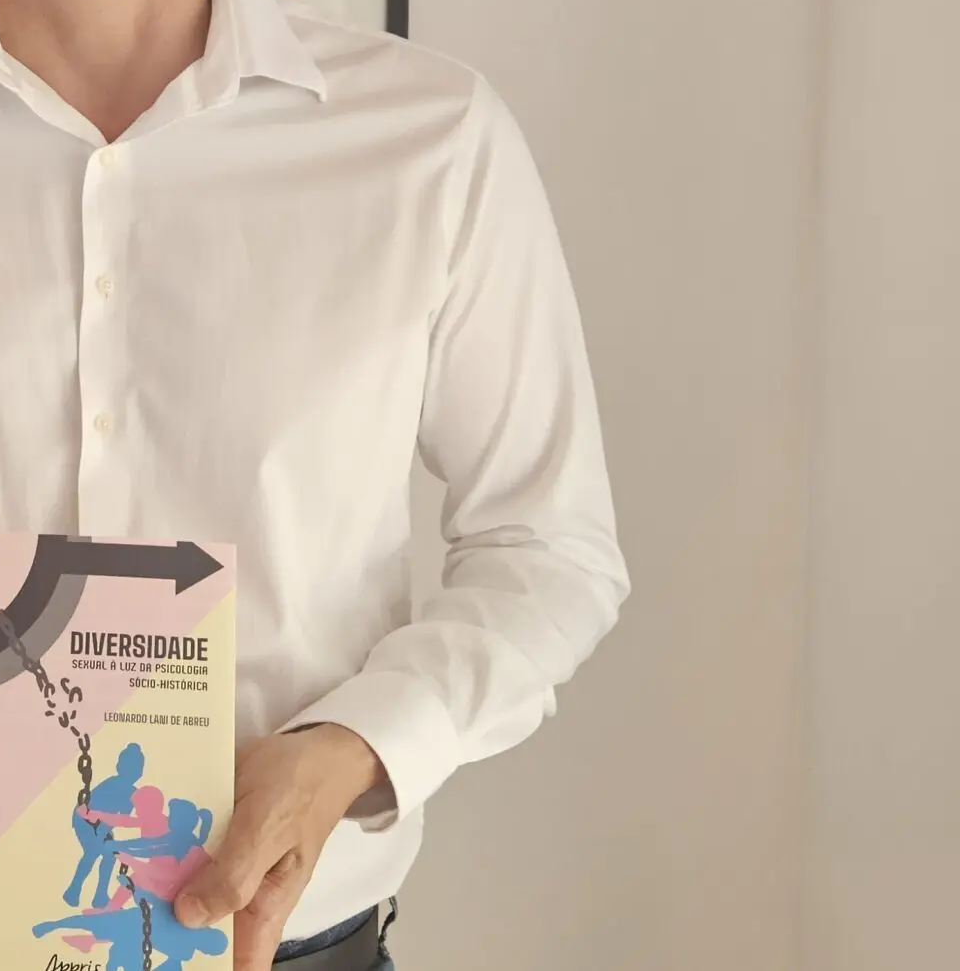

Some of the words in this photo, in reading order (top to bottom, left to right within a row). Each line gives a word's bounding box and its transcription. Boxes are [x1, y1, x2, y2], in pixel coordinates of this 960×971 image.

[70, 631, 208, 661] DIVERSIDADE
[72, 659, 107, 671] SEXUAL
[110, 660, 117, 671] À
[120, 662, 136, 672] LUZ
[140, 663, 152, 673] DA
[155, 663, 208, 675] PSICOLOGIA
[129, 677, 208, 691] SÓCIO-HISTÓRICA
[104, 712, 147, 725] LEONARDO
[149, 713, 168, 725] LANI
[170, 714, 181, 726] DE
[183, 715, 210, 727] ABREU
